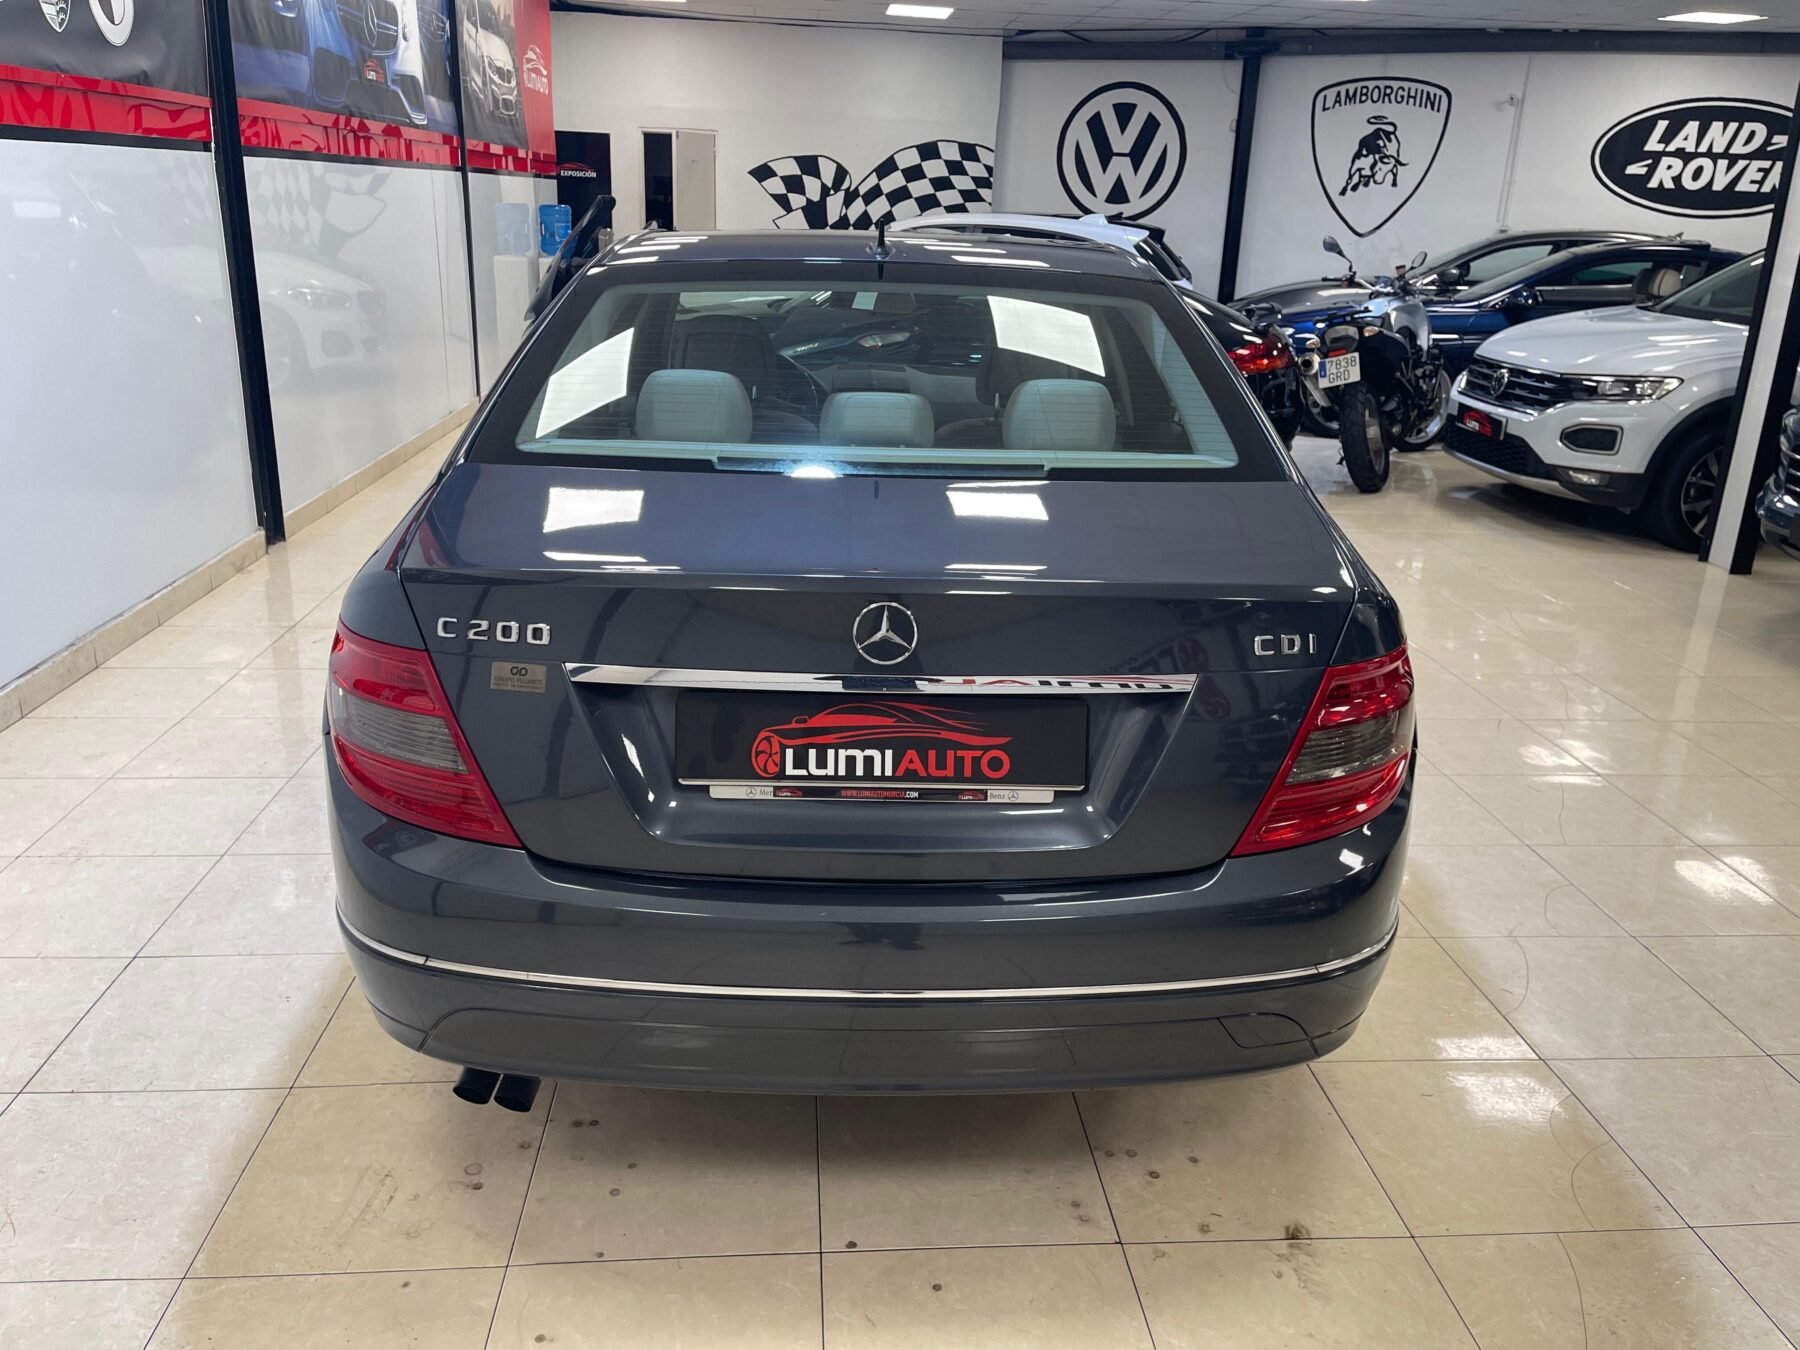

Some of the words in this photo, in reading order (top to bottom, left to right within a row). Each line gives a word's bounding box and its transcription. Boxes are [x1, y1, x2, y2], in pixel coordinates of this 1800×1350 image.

[1322, 85, 1442, 113] LAMBORGHINI
[1643, 119, 1768, 154] LAND
[1327, 355, 1357, 372] 7838
[1328, 369, 1350, 384] GRD
[1254, 633, 1317, 656] CDI
[784, 747, 1011, 779] LUMIAUTO
